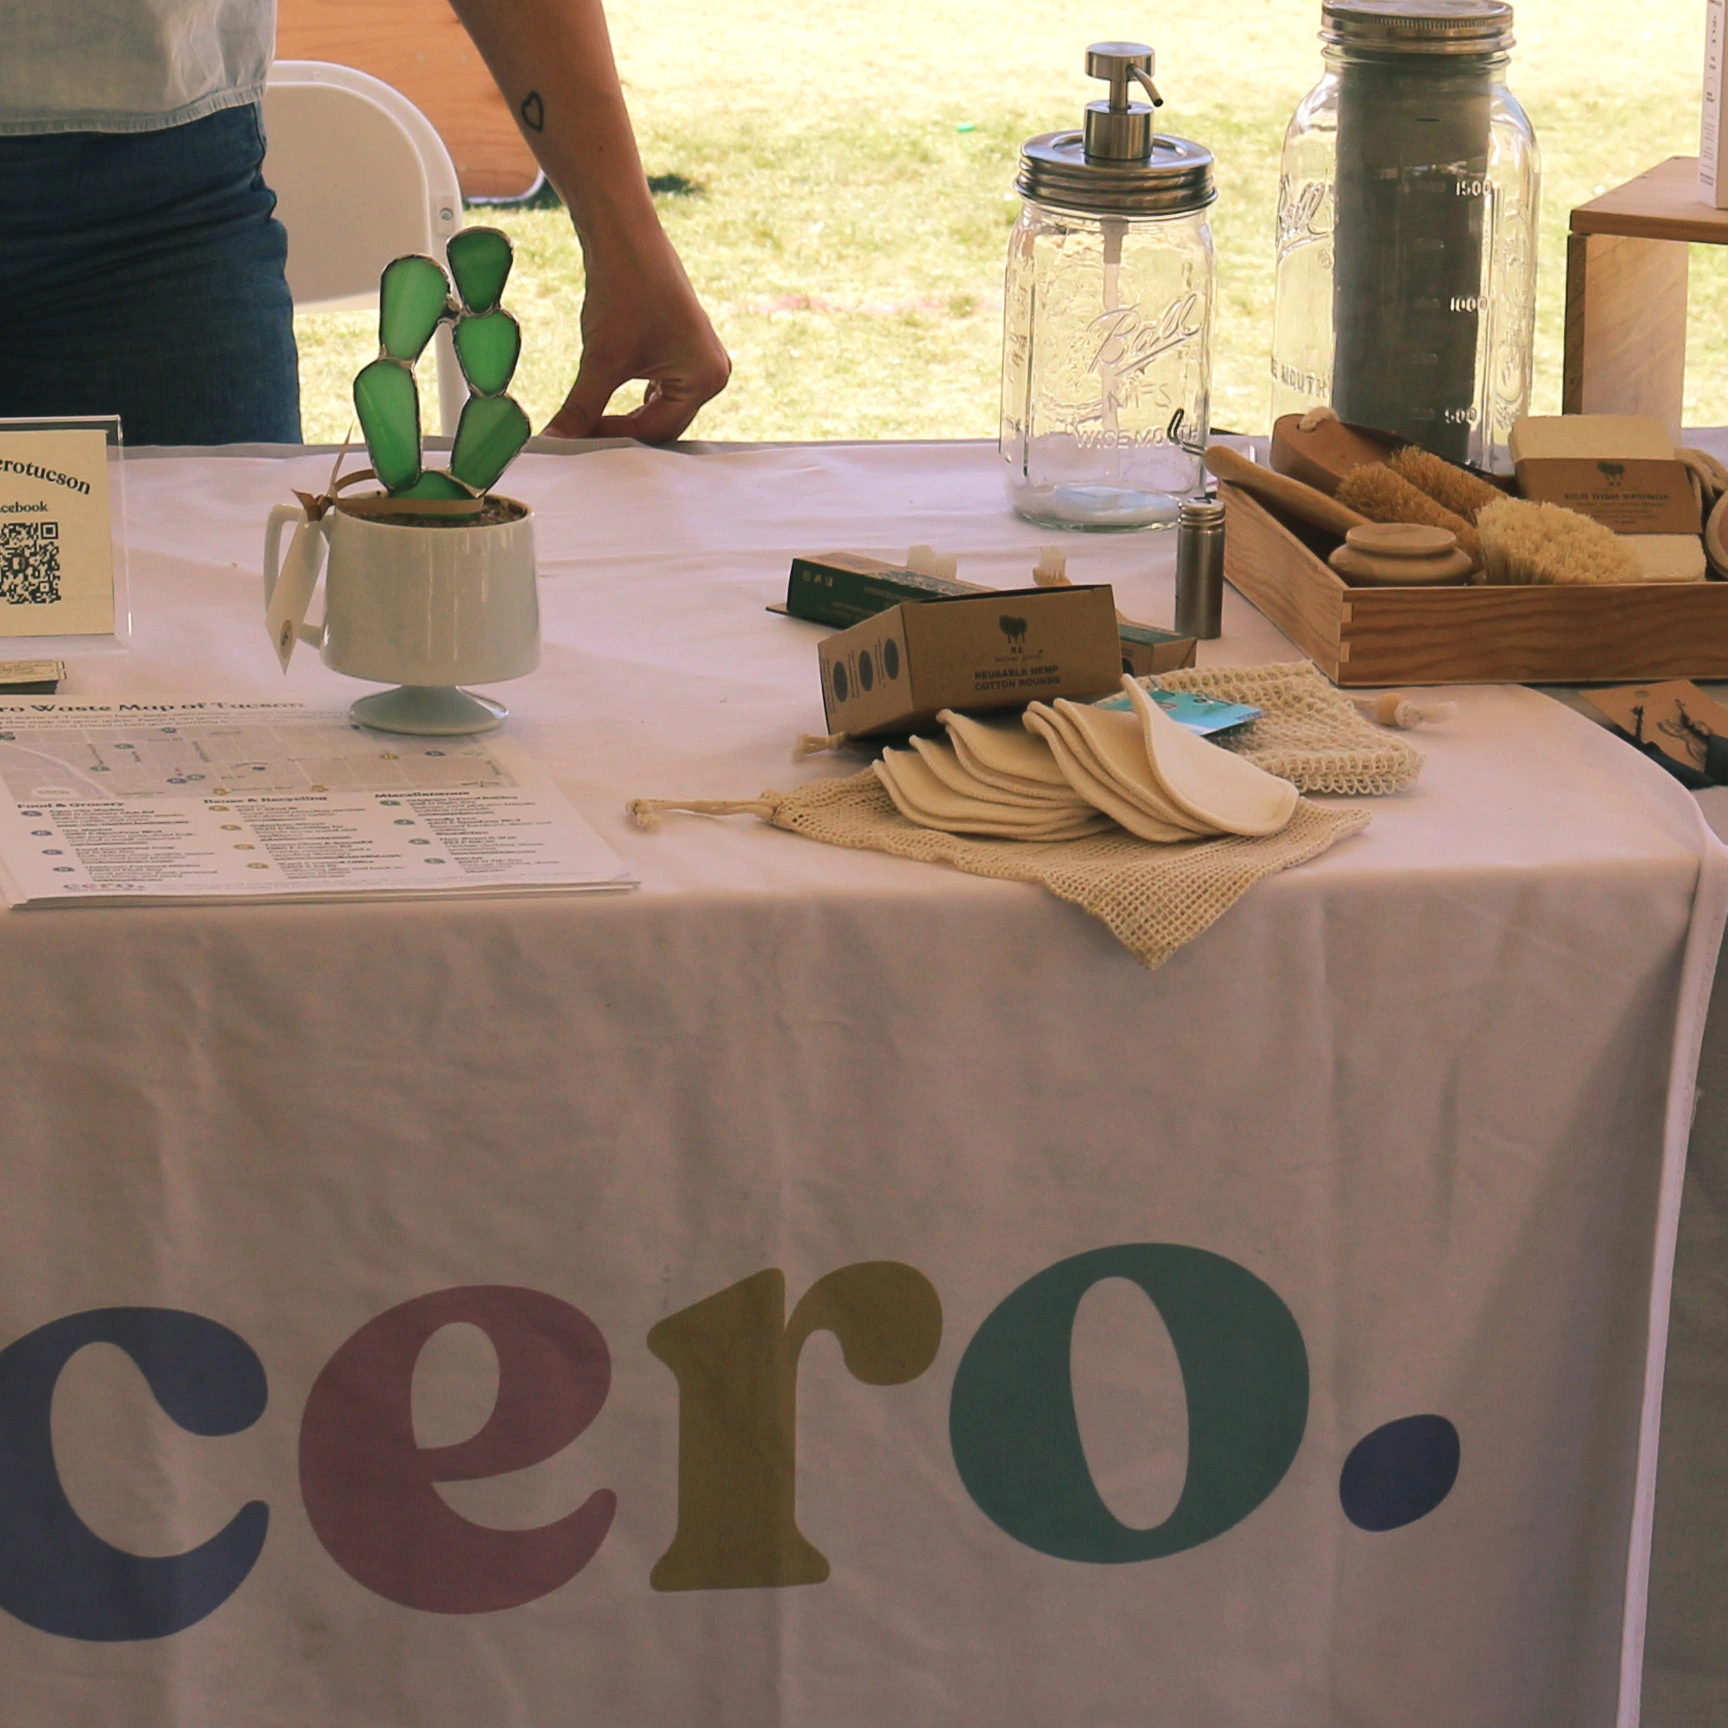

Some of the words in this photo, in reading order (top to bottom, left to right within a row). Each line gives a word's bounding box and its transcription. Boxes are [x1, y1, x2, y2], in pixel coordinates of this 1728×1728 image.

[1456, 180, 1493, 197] 1500
[1086, 293, 1201, 375] Ball
[1030, 665, 1058, 674] HEMP
[974, 680, 1016, 691] COTTON
[1019, 676, 1061, 687] ROUNDS
[30, 704, 112, 713] Waste
[120, 703, 176, 714] Map
[181, 702, 207, 710] of
